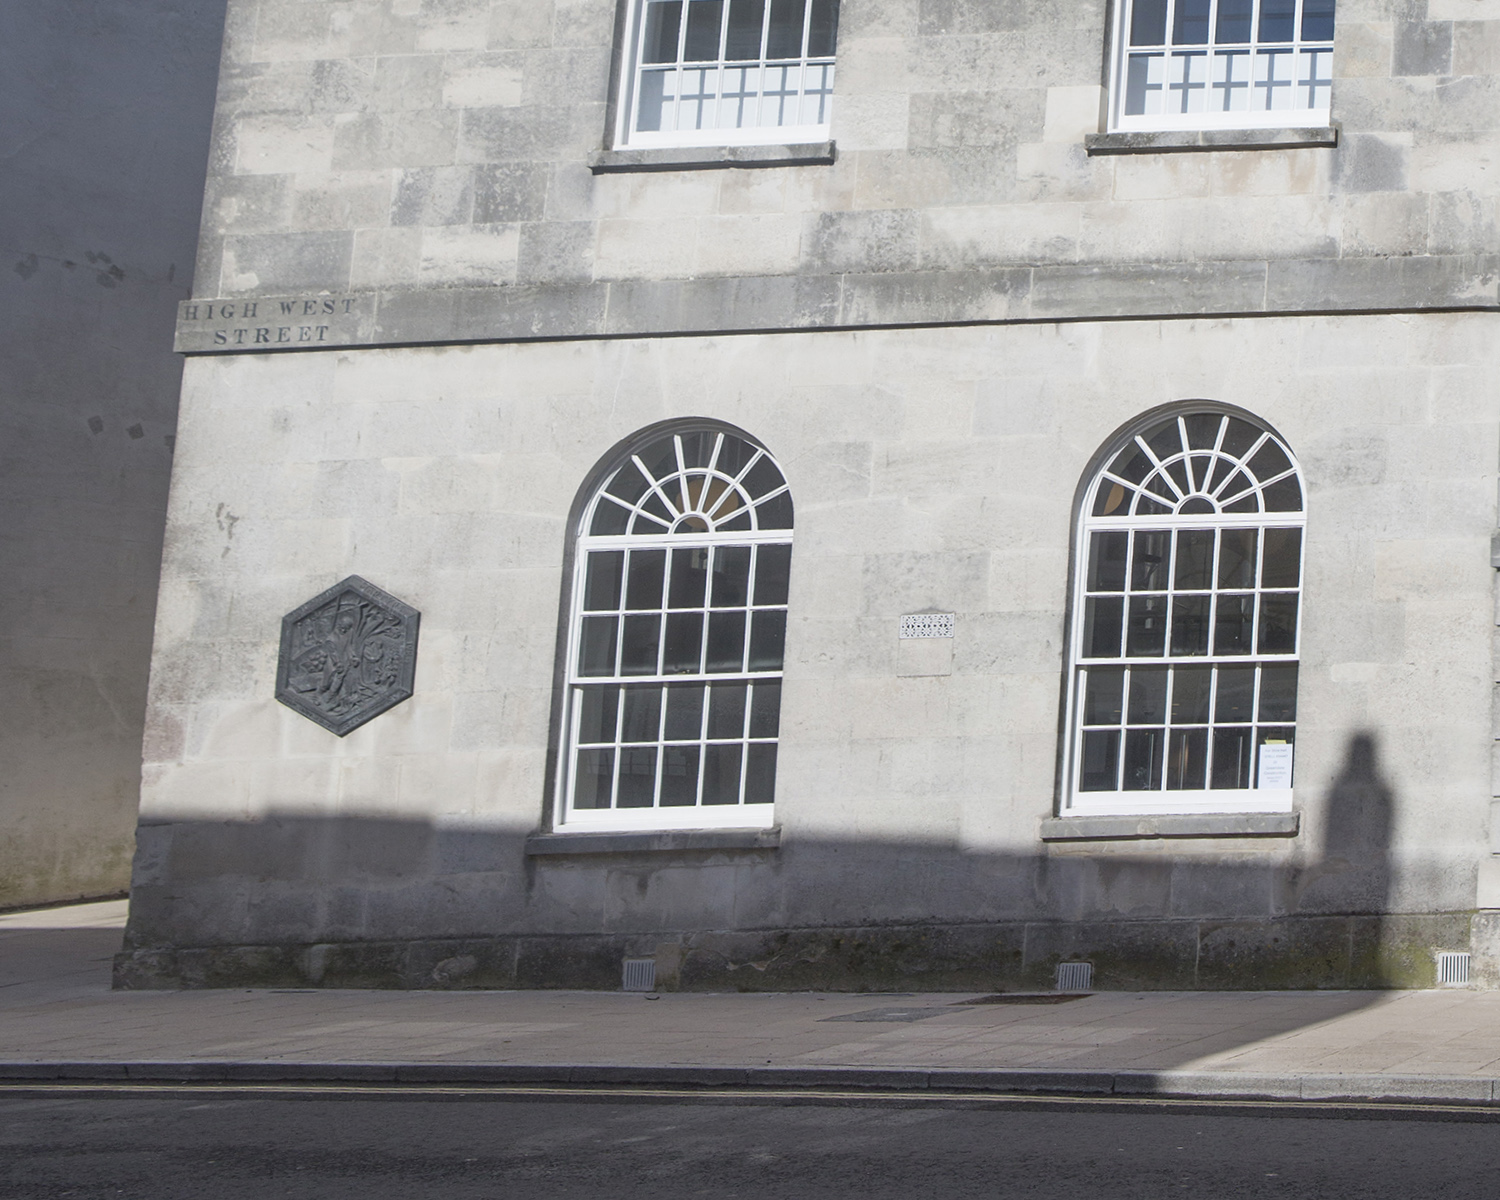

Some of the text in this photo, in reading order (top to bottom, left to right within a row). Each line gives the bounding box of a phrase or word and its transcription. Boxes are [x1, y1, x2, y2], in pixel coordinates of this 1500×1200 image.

[184, 298, 356, 321] HIGH WEST
[213, 325, 330, 346] STREET
